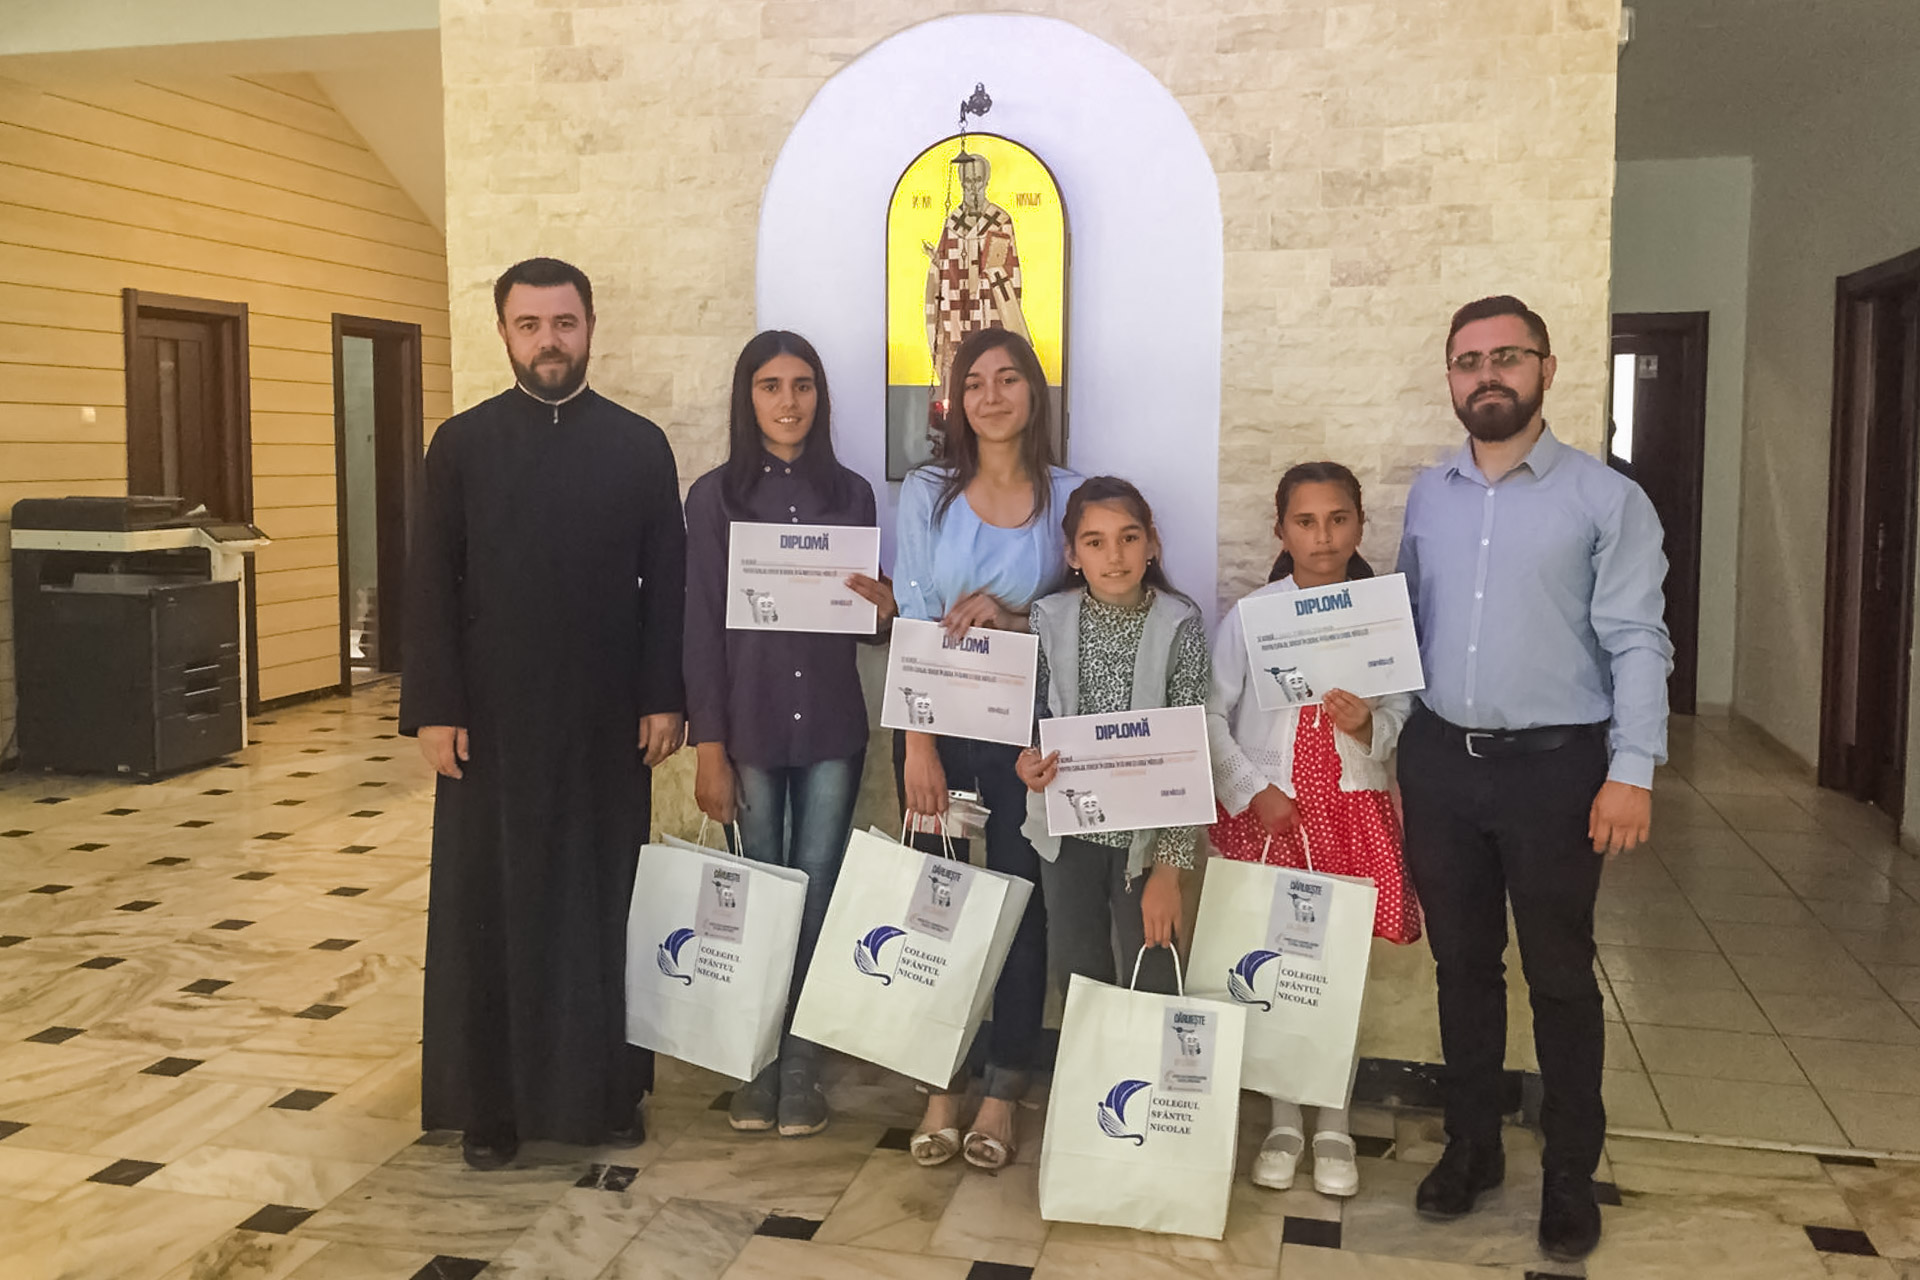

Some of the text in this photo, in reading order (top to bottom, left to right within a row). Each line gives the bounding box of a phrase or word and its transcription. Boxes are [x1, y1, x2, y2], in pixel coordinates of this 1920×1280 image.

[780, 533, 829, 551] DIPLOMĂ
[1295, 588, 1352, 616] DIPLOMĂ
[1095, 718, 1151, 740] DIPLOMĂ
[701, 946, 741, 962] COLEGIUL
[904, 946, 948, 966] COLEGIUL
[697, 968, 732, 983] NICOLAE
[898, 968, 936, 987] NICOLAE
[1281, 968, 1329, 984] COLEGIUL
[1277, 992, 1319, 1007] NICOLAE
[1152, 1097, 1200, 1109] COLEGIUL
[1149, 1123, 1192, 1135] NICOLAE
